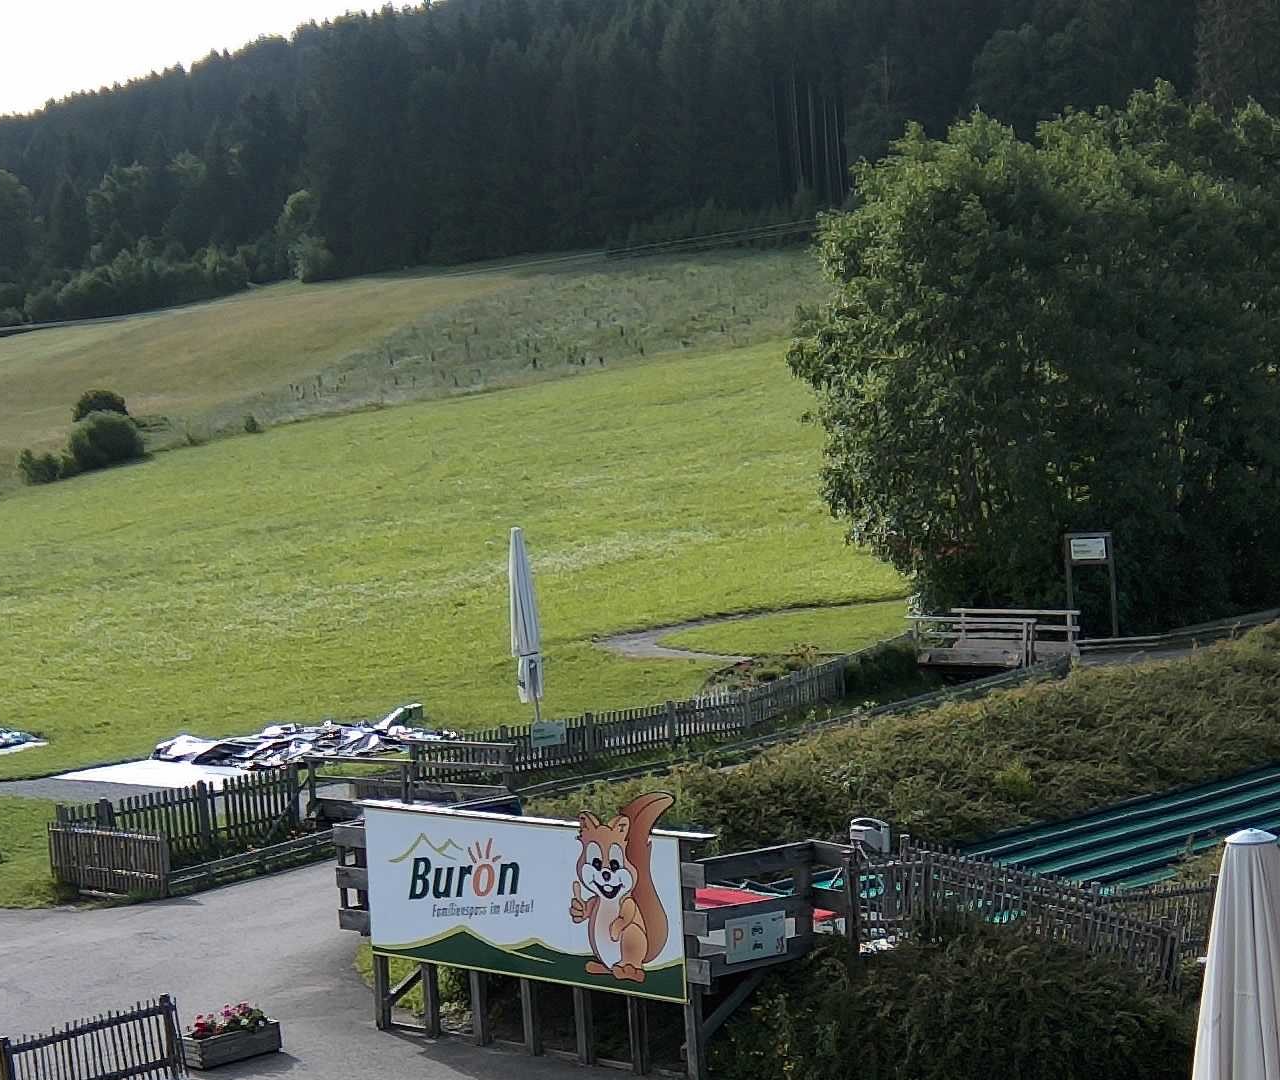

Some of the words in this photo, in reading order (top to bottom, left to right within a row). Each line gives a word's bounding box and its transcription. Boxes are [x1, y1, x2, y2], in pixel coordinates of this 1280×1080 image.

[408, 856, 520, 900] Buron
[489, 902, 501, 915] im
[733, 927, 744, 950] P
